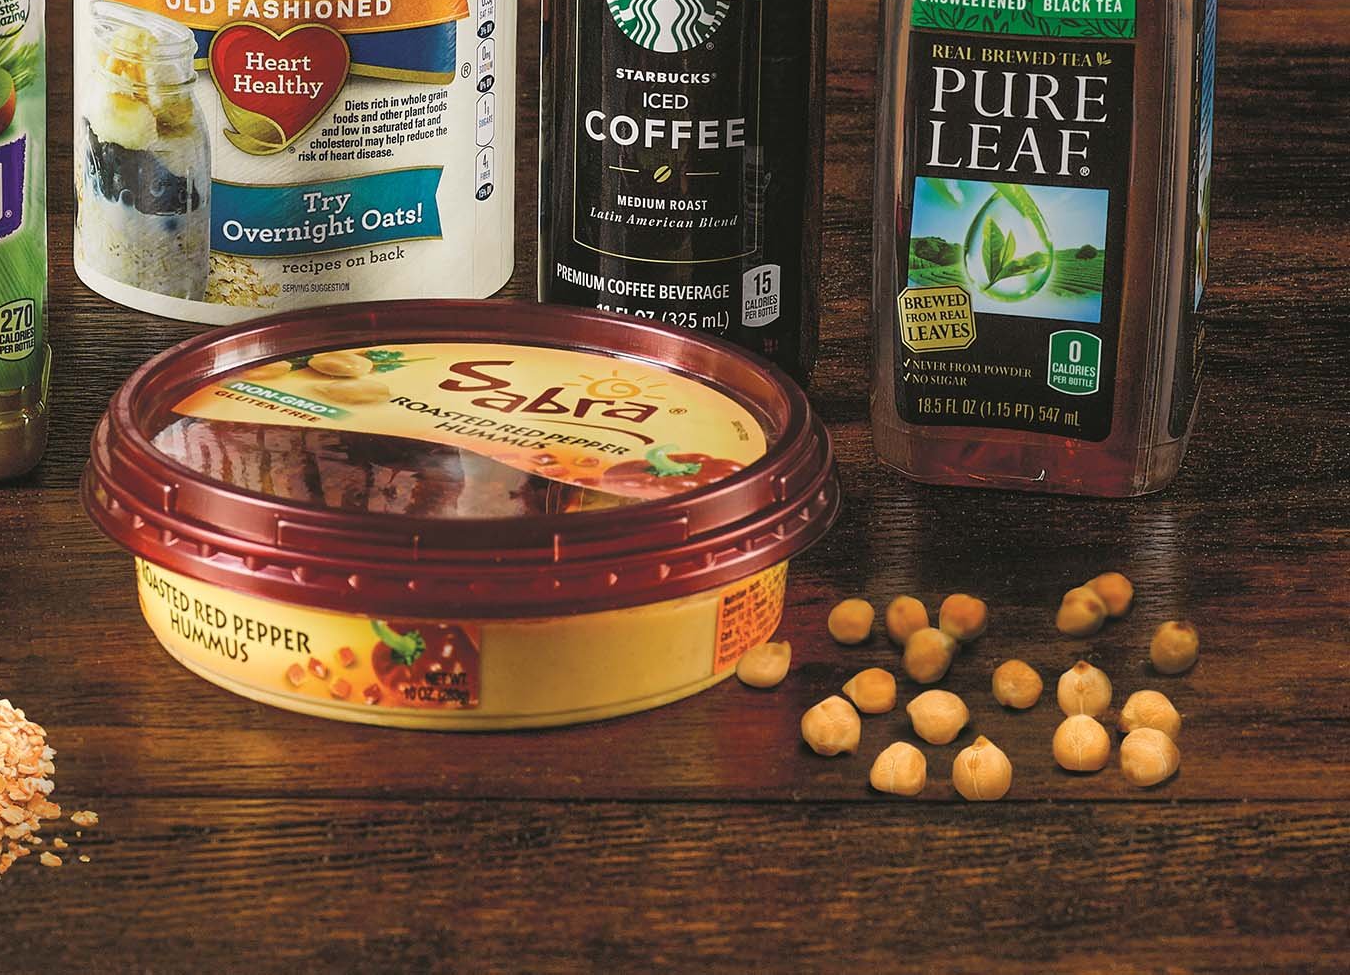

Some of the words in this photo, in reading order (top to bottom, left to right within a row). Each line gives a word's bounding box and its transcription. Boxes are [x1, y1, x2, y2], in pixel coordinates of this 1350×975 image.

[245, 50, 311, 73] Heart
[931, 43, 976, 62] REAL
[981, 47, 1056, 66] BREWED
[1058, 51, 1092, 67] TEA
[233, 73, 324, 99] Healthy
[616, 67, 711, 84] STARBUCKS
[345, 100, 369, 111] Diets
[371, 98, 389, 110] rich
[401, 92, 427, 107] whole
[428, 90, 448, 104] grain
[643, 91, 689, 110] ICED
[929, 65, 1109, 124] PURE
[333, 113, 359, 125] foods
[361, 111, 378, 122] and
[380, 108, 402, 121] other
[404, 105, 425, 120] plant
[426, 101, 448, 115] foods
[321, 127, 340, 137] and
[341, 126, 360, 137] low
[372, 119, 414, 134] saturated
[415, 117, 426, 129] fat
[427, 114, 441, 126] and
[584, 109, 746, 150] COFFEE
[310, 136, 363, 150] cholesterol
[364, 136, 384, 148] may
[386, 131, 405, 147] help
[406, 128, 435, 143] reduce
[435, 126, 448, 137] the
[925, 119, 1090, 176] LEAF
[298, 150, 316, 162] risk
[330, 148, 355, 161] heart
[356, 146, 394, 159] disease.
[302, 191, 351, 215] Try
[617, 194, 666, 210] MEDIUM
[669, 199, 708, 211] ROAST
[222, 214, 355, 245] Overnight
[361, 202, 423, 232] Oats!
[590, 206, 623, 224] Latin
[626, 214, 694, 228] American
[699, 214, 738, 228] Blend
[282, 256, 342, 276] recipes
[346, 256, 366, 268] on
[369, 245, 405, 264] back
[556, 262, 605, 292] PREMIUM
[607, 278, 656, 299] COFFEE
[659, 284, 730, 300] BEVERAGE
[753, 270, 772, 296] 15
[745, 294, 778, 311] CALORIES
[903, 293, 968, 310] BREWED
[0, 304, 33, 333] 270
[905, 311, 938, 323] FROM
[940, 309, 968, 321] REAL
[0, 327, 35, 345] CALORIES
[907, 322, 971, 343] LEAVES
[912, 359, 947, 372] NEVER
[950, 362, 982, 374] FROM
[984, 365, 1033, 378] POWDER
[1051, 362, 1096, 378] CALORIES
[438, 360, 659, 424] Sabra
[1052, 375, 1067, 385] PER
[1068, 377, 1094, 388] BOTTLE
[214, 389, 280, 412] GLUTEN
[280, 407, 322, 423] FREE
[917, 397, 942, 414] 18.5
[945, 399, 958, 414] FL
[962, 399, 976, 415] OZ
[980, 401, 1011, 419] (1.15
[1014, 404, 1034, 423] PT)
[1038, 406, 1060, 423] 547
[1064, 410, 1080, 427] mL
[389, 396, 498, 428] ROASTED
[496, 422, 546, 439] RED
[543, 433, 632, 456] PEPPER
[433, 421, 553, 451] HUMMUS
[170, 609, 249, 663] HUMMUS
[194, 599, 227, 629] RED
[233, 614, 312, 655] PEPPER
